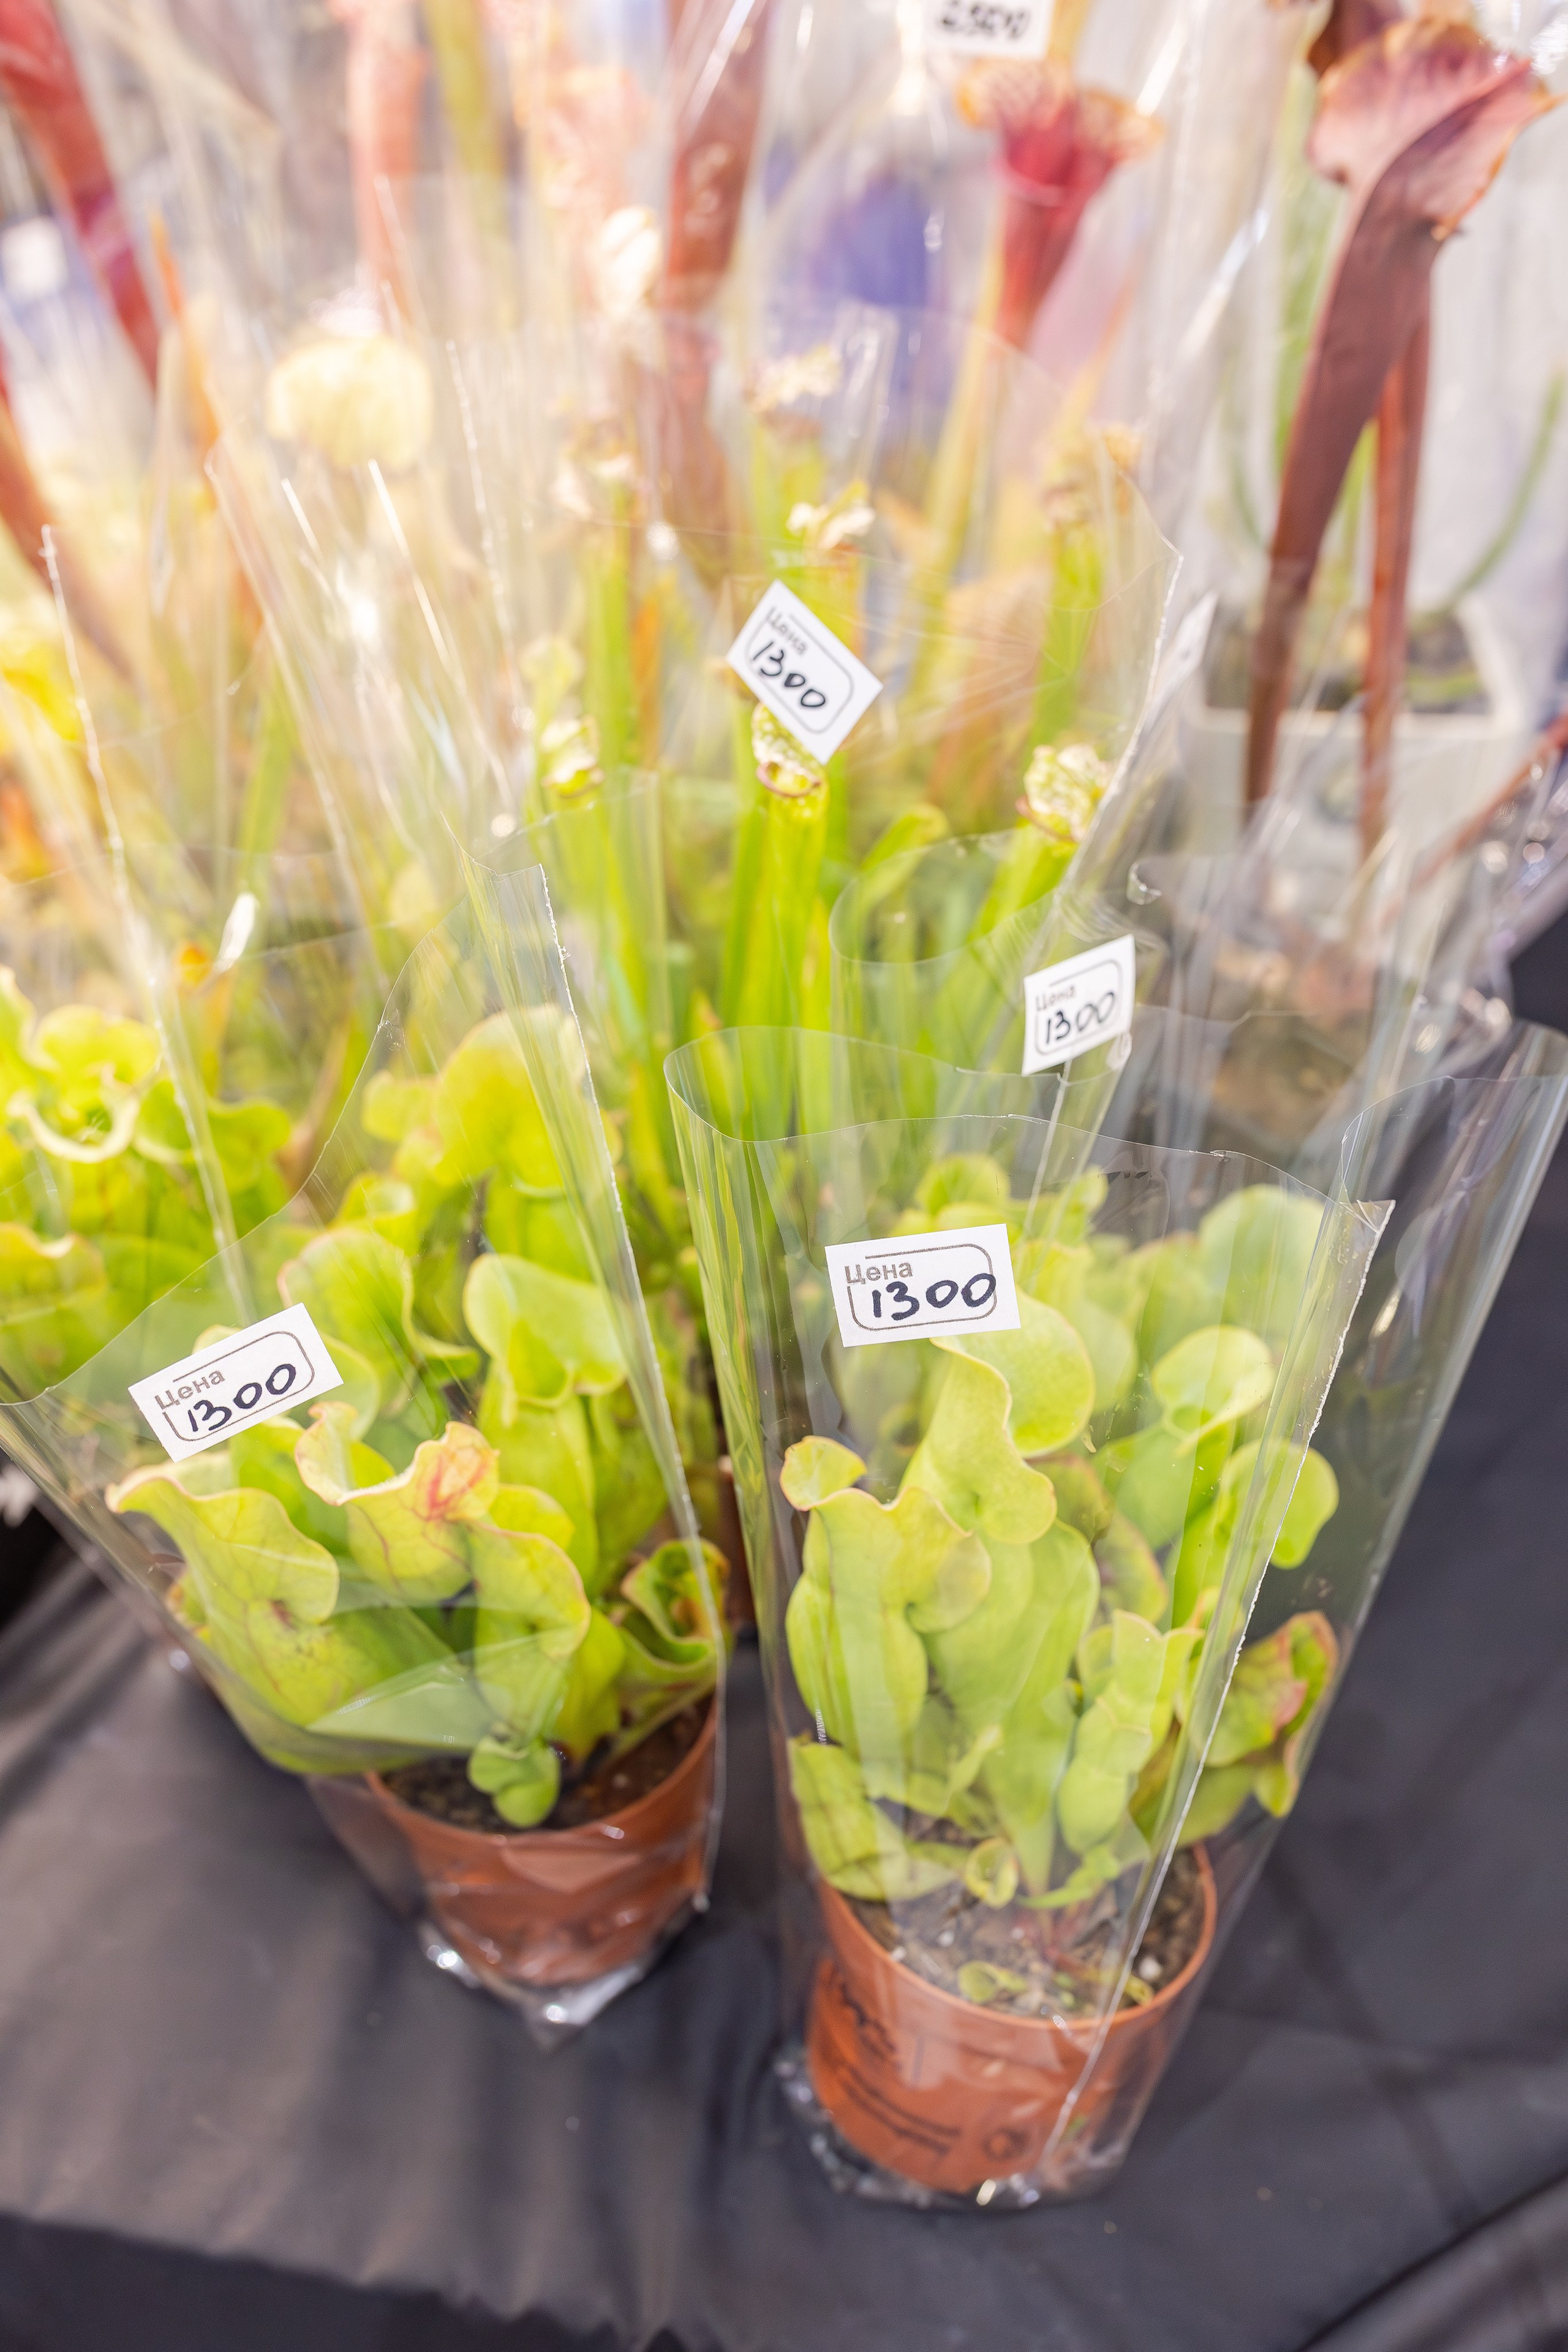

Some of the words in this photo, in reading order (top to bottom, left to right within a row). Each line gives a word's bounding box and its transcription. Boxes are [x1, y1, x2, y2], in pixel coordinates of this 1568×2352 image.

[766, 607, 808, 656] Цена
[753, 641, 826, 707] 1300
[1046, 992, 1115, 1044] 1300
[844, 1262, 913, 1285] Цена
[872, 1273, 996, 1321] 1300
[154, 1370, 225, 1410] Цена
[187, 1363, 296, 1432] 1300
